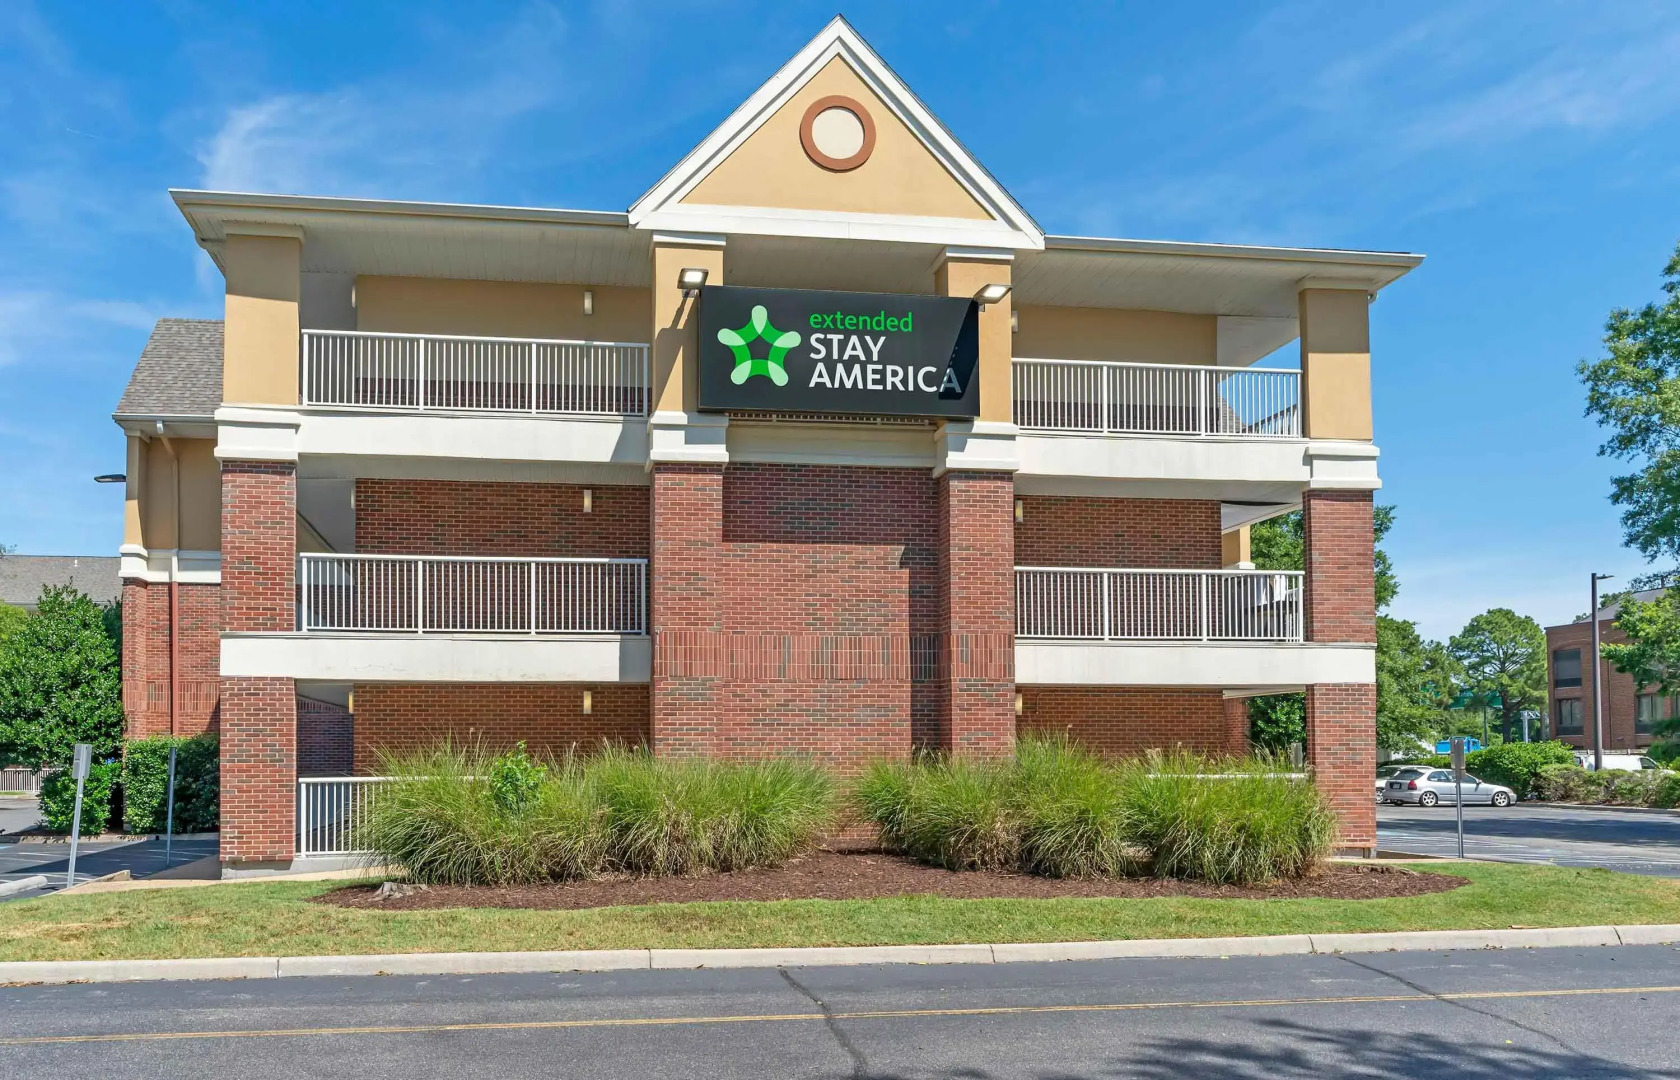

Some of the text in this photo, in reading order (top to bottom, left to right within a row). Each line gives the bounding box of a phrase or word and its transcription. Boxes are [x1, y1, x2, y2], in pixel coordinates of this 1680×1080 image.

[809, 310, 912, 332] extended
[809, 333, 886, 361] STAY
[808, 362, 962, 393] AMERICA
